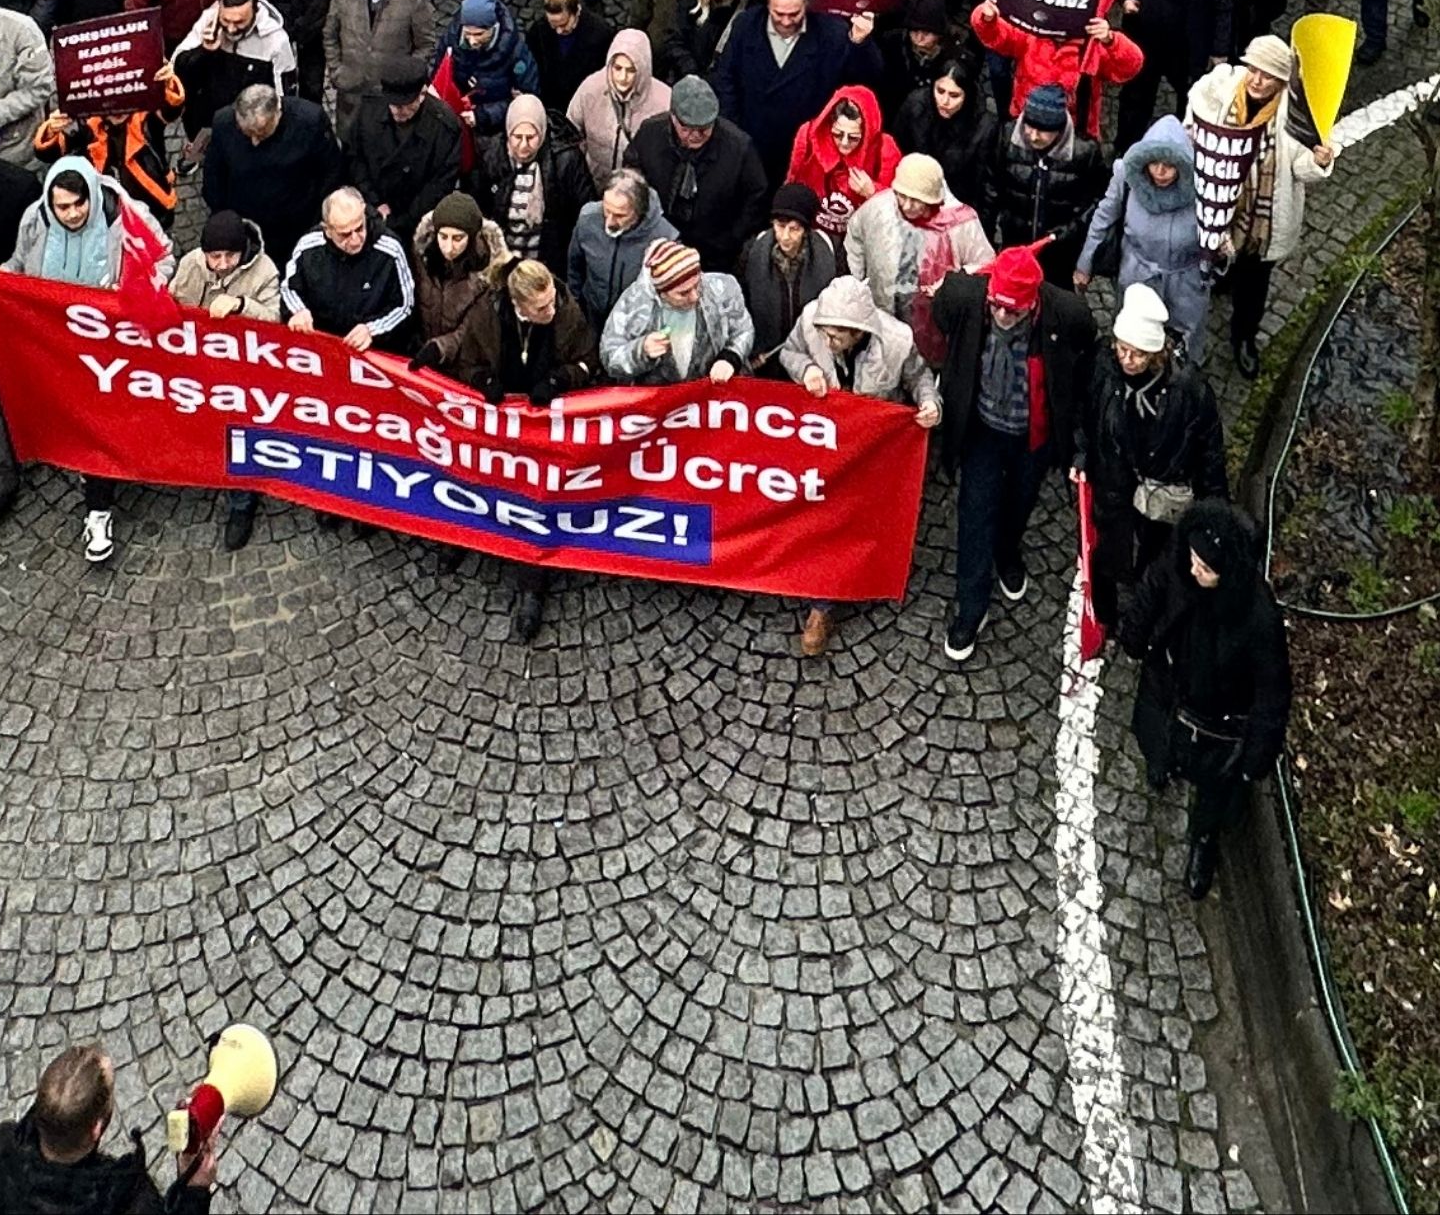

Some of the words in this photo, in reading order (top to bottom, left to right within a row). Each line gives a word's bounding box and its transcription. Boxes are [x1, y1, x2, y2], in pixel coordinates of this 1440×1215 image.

[58, 20, 149, 48] YOKSULLUK
[78, 41, 131, 59] KADER
[69, 78, 91, 89] BU
[93, 68, 145, 85] ÜCRET
[82, 56, 127, 73] DEĞİL
[65, 89, 101, 101] ADİL
[103, 81, 148, 96] DEĞİL
[1197, 127, 1253, 156] ADAKA
[66, 304, 324, 377] Sadaka
[79, 354, 602, 492] Yaşayacağımız
[628, 437, 825, 503] Ücret
[230, 429, 689, 546] İSTİYORUZ!
